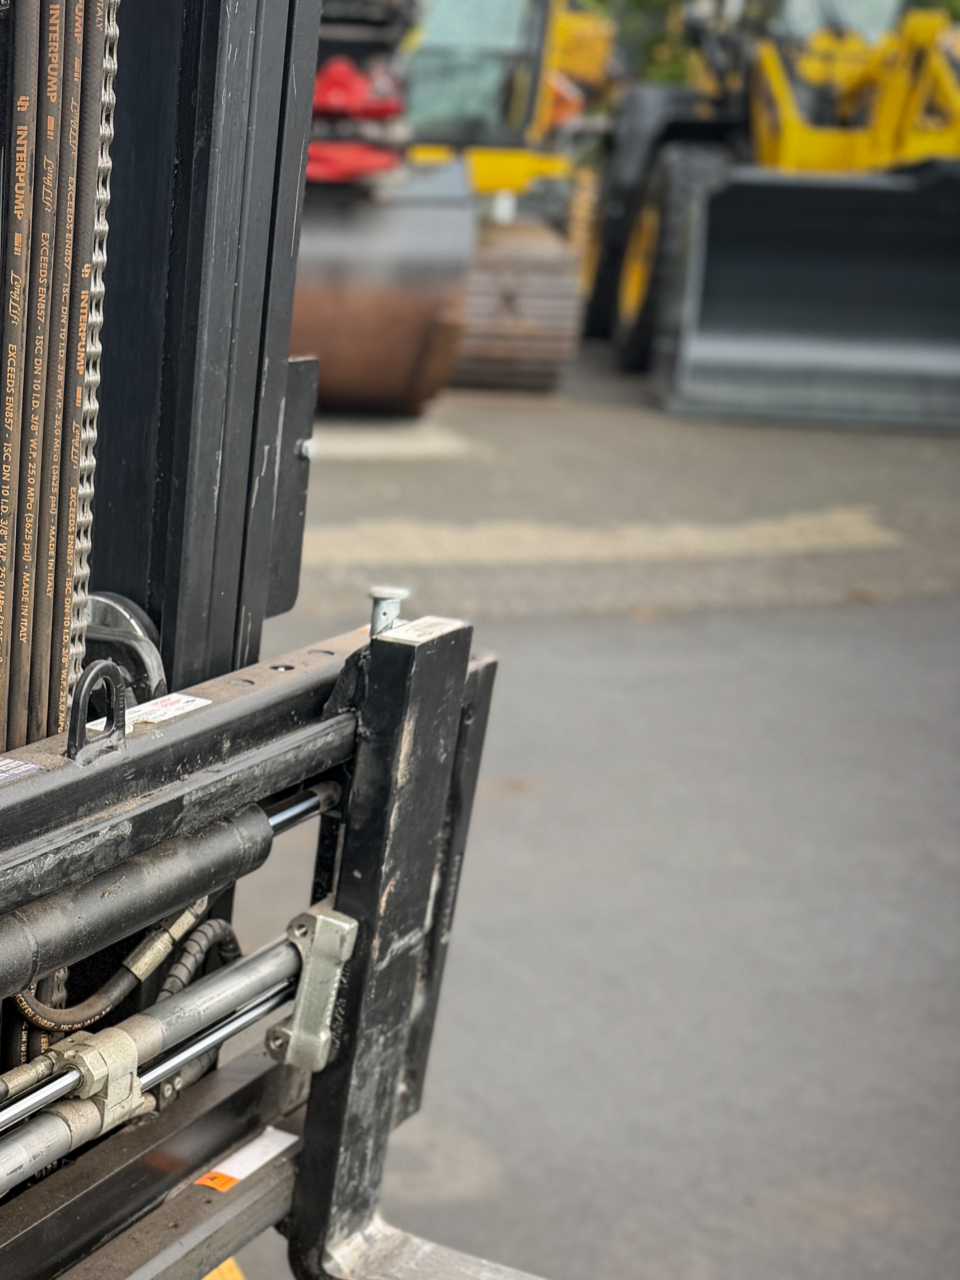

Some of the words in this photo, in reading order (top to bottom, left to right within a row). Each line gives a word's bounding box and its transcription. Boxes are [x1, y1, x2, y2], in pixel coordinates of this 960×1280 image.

[47, 4, 60, 102] INTERPUMP
[13, 126, 28, 220] INTERPUMP
[66, 177, 76, 230] EXCEEDS
[39, 232, 49, 284] EXCEEDS
[64, 233, 72, 269] EN857
[62, 282, 70, 303] 1SC
[36, 287, 46, 323] EN857
[60, 306, 68, 324] DN
[59, 327, 67, 339] 10
[76, 290, 89, 375] INTERPUMP
[34, 335, 43, 354] 1SC
[58, 342, 66, 360] I.D.
[6, 344, 17, 393] EXCEEDS
[33, 358, 42, 375] DN
[32, 379, 41, 390] 10
[31, 393, 40, 410] I.D.
[55, 389, 63, 410] W.P.
[4, 396, 14, 431] EN857
[2, 442, 12, 461] 1SC
[29, 438, 38, 459] W.P.
[52, 438, 60, 461] MPa
[1, 464, 11, 480] DN
[50, 465, 59, 494] (3625
[1, 485, 10, 496] 10
[26, 487, 35, 510] MPa
[0, 499, 9, 516] I.D.
[68, 487, 77, 532] EXCEEDS
[24, 513, 34, 540] (3625
[48, 525, 56, 556] MADE
[66, 535, 74, 566] EN857
[47, 559, 55, 570] IN
[21, 572, 31, 602] MADE
[46, 573, 54, 598] ITALY
[64, 577, 72, 595] 1SC
[21, 605, 29, 616] IN
[64, 598, 71, 613] DN
[20, 618, 29, 643] ITALY
[63, 616, 70, 626] 10
[57, 712, 65, 734] MPa
